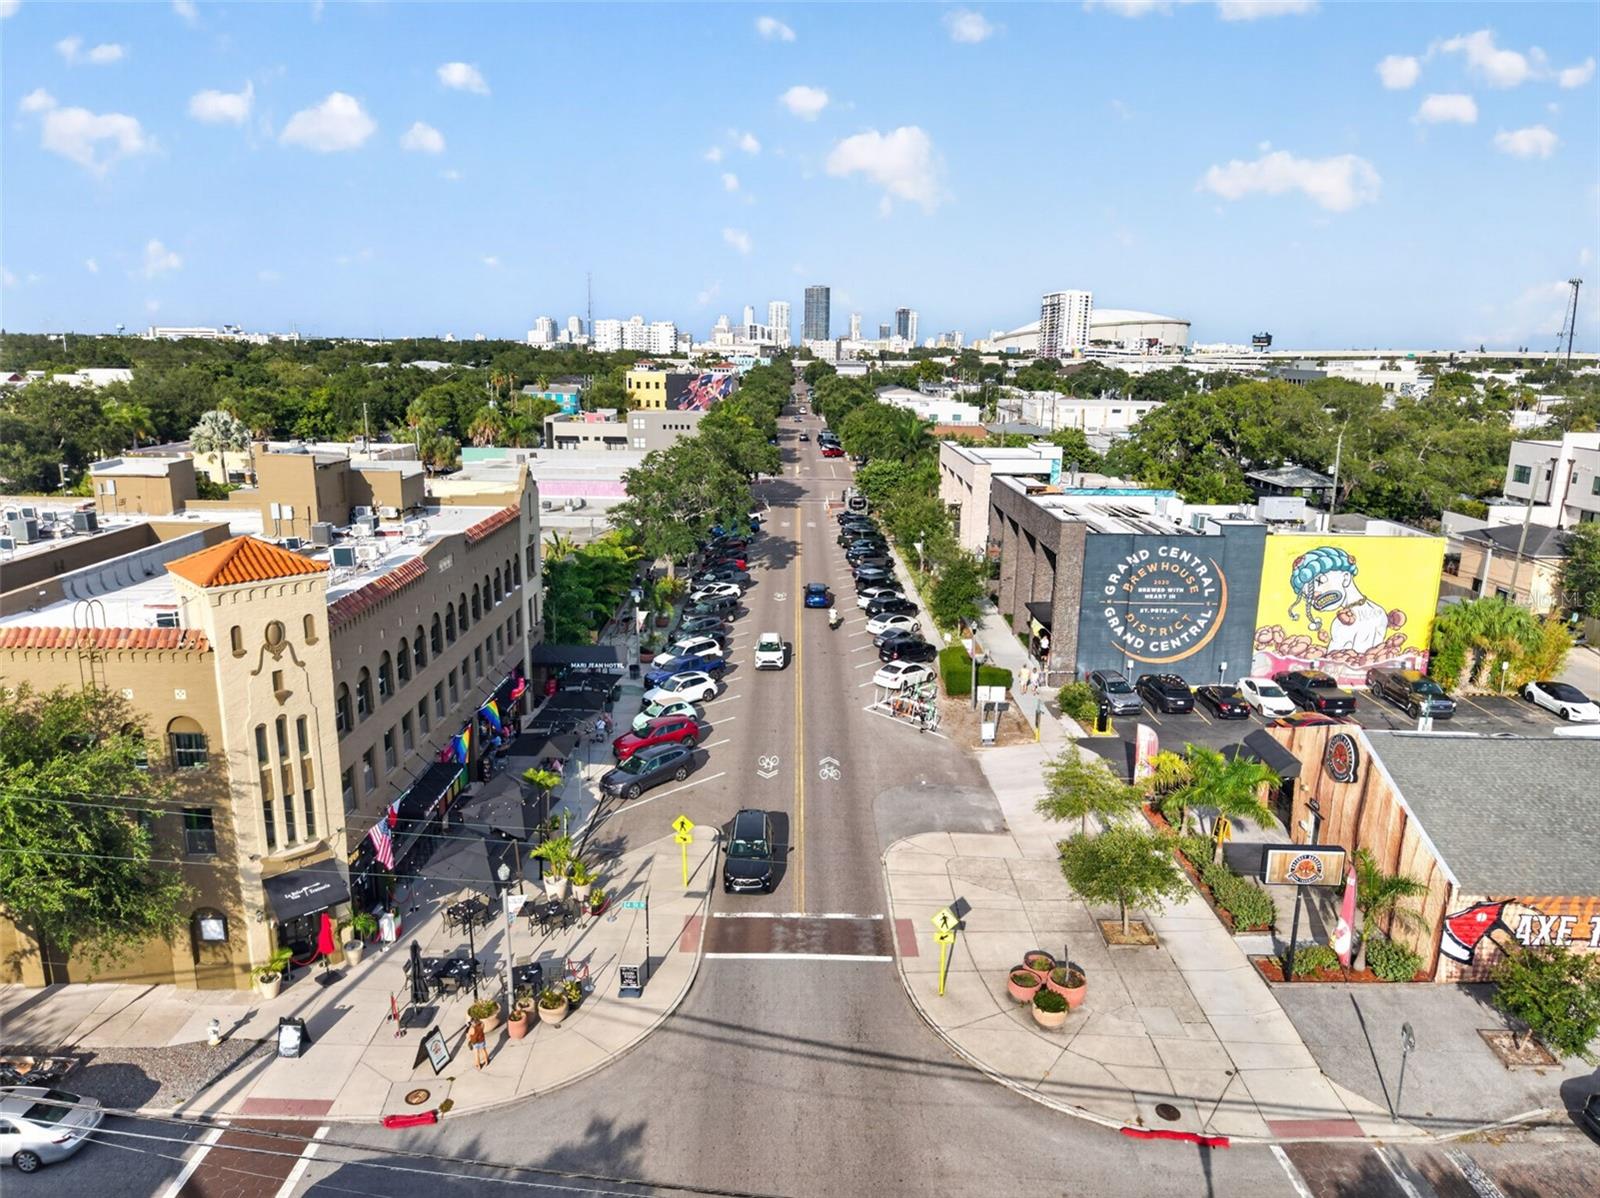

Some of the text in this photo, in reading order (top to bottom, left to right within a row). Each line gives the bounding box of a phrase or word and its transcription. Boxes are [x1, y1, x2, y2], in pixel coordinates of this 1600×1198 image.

[1104, 545, 1216, 597] GRAND CENTRAL
[1123, 562, 1199, 594] BREWHOUSE
[1104, 607, 1213, 652] GRAND CENTRAL
[1124, 612, 1192, 636] DISTRICT
[1516, 915, 1578, 947] AXE
